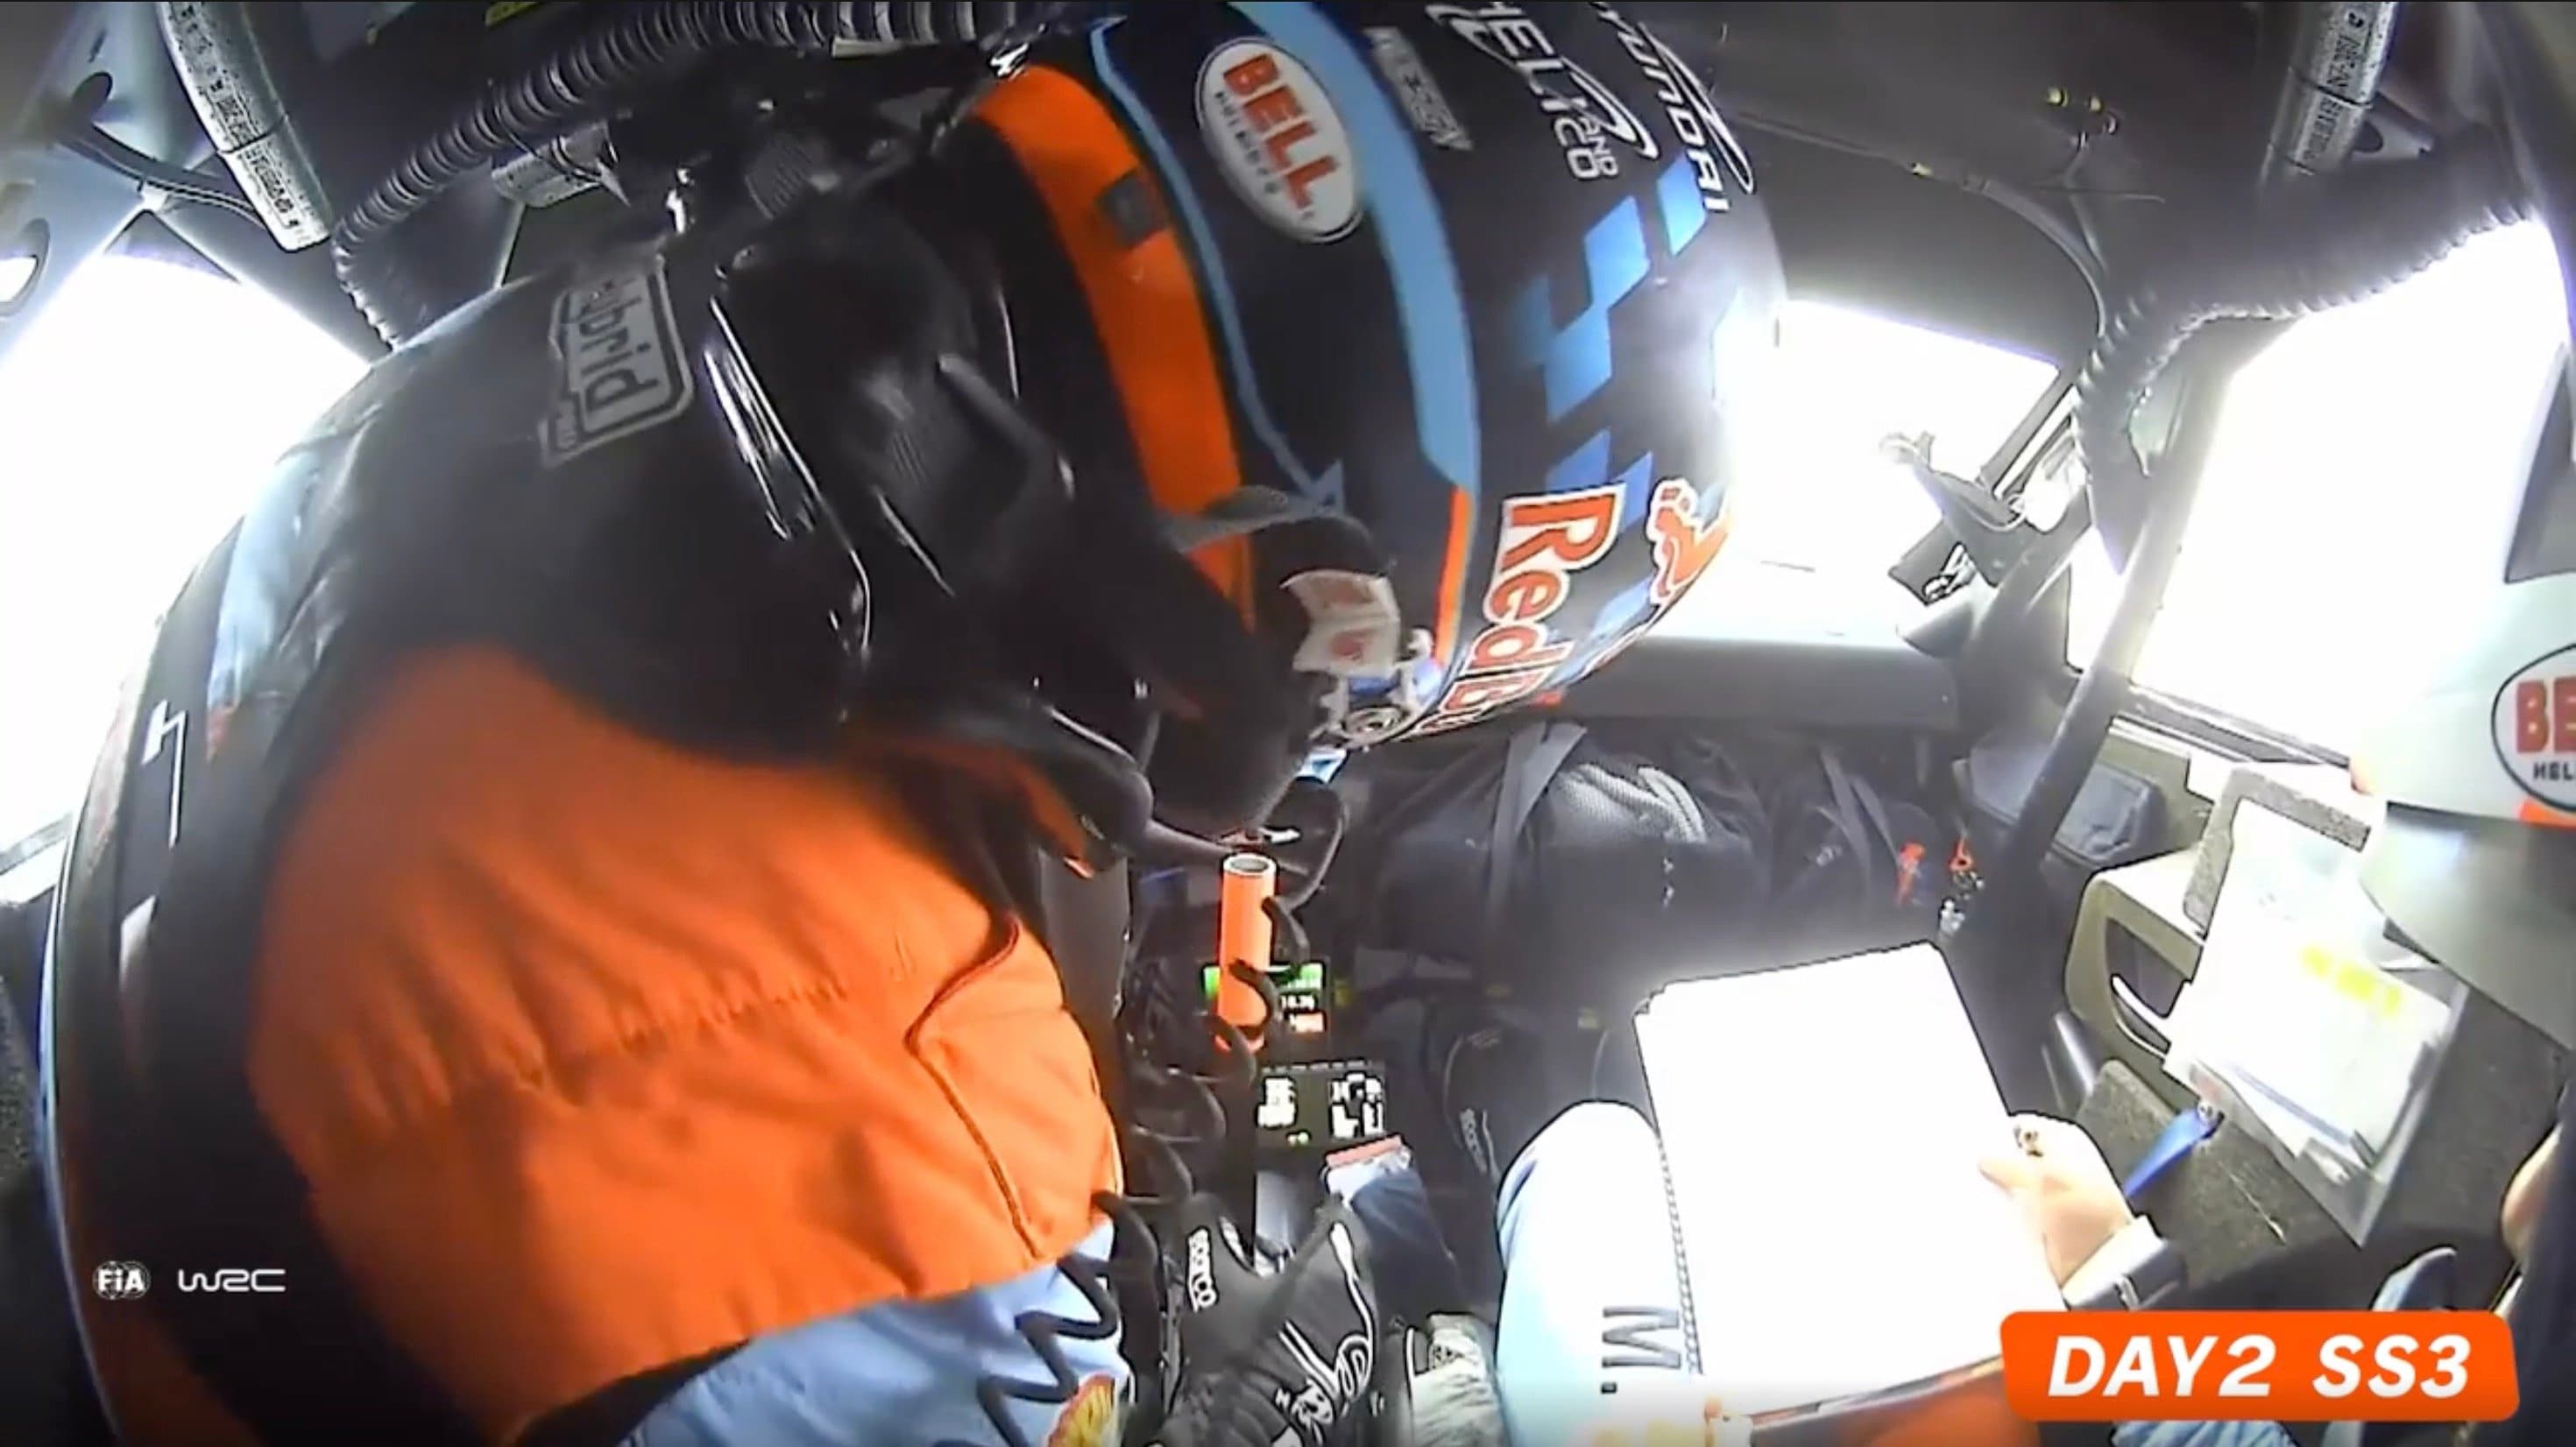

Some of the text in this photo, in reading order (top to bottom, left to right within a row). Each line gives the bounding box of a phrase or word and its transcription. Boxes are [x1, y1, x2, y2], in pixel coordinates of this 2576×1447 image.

[1223, 53, 1340, 208] BELL
[1588, 2, 1730, 212] YUNDAI
[1464, 486, 1622, 672] Red
